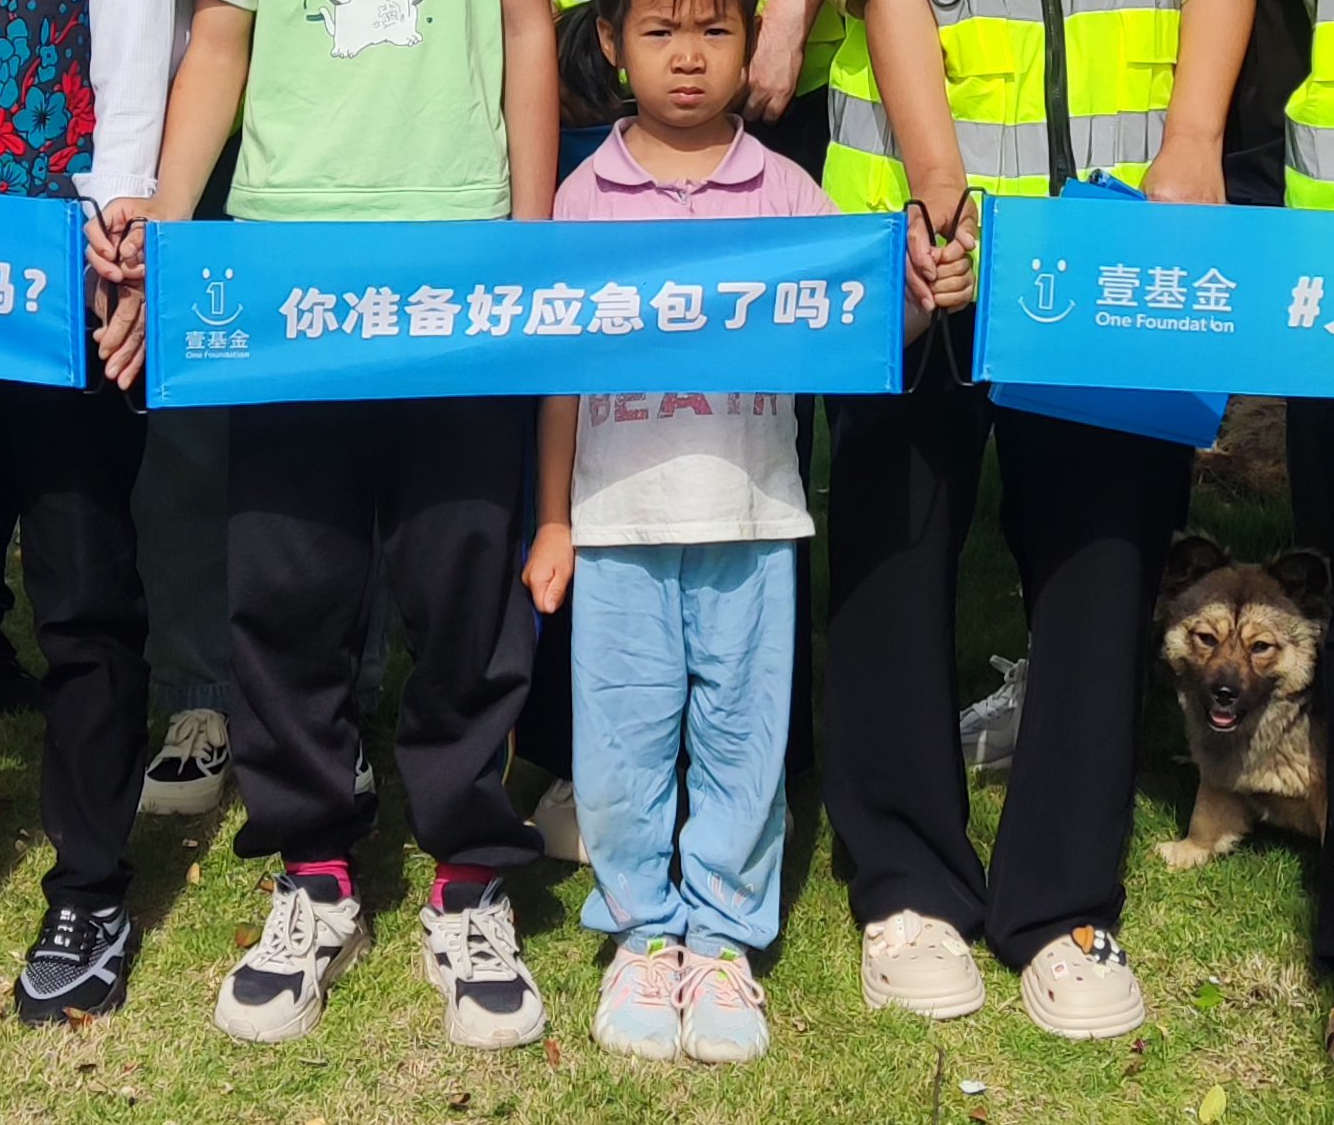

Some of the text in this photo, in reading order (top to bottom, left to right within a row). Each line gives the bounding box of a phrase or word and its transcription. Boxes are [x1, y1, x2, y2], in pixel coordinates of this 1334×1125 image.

[1096, 263, 1237, 312] 壹基金
[278, 279, 866, 339] 你准备好应急包了吗?
[1095, 311, 1235, 334] One Foundation
[185, 329, 250, 349] 壹基金
